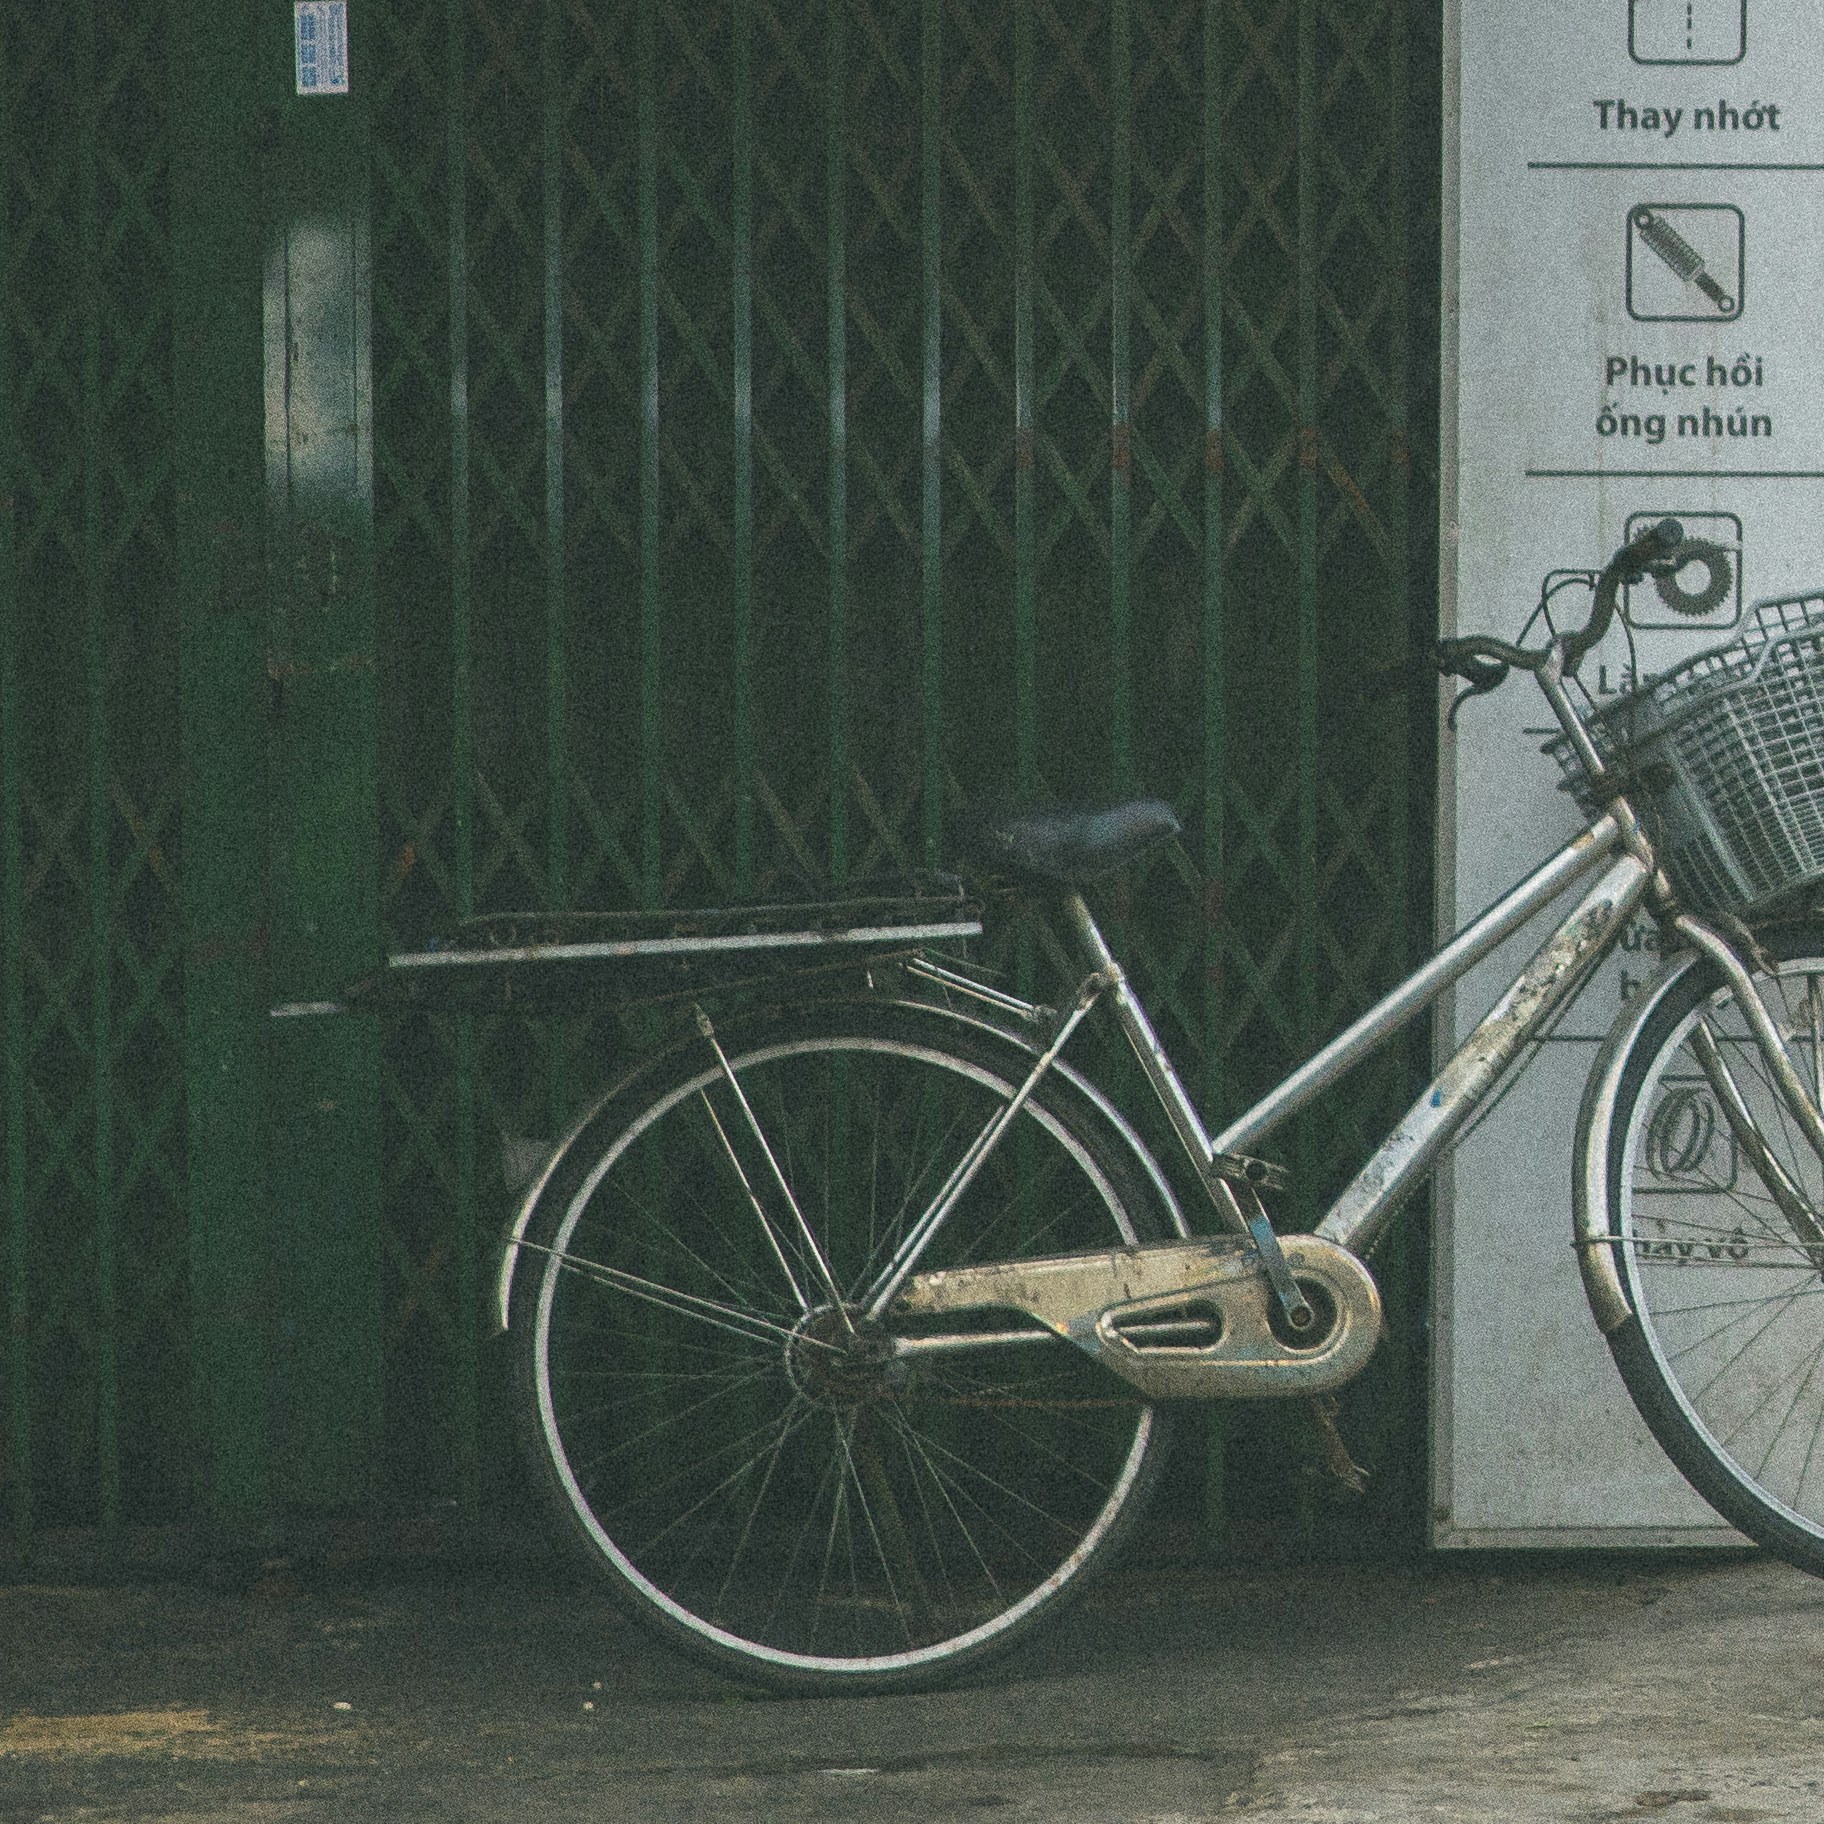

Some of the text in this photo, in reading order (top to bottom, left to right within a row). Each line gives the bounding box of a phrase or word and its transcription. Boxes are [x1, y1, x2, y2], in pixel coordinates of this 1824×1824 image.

[1592, 96, 1781, 138] Thay nhớt
[1604, 350, 1765, 396] Phục hồi
[1594, 402, 1774, 445] ống nhún
